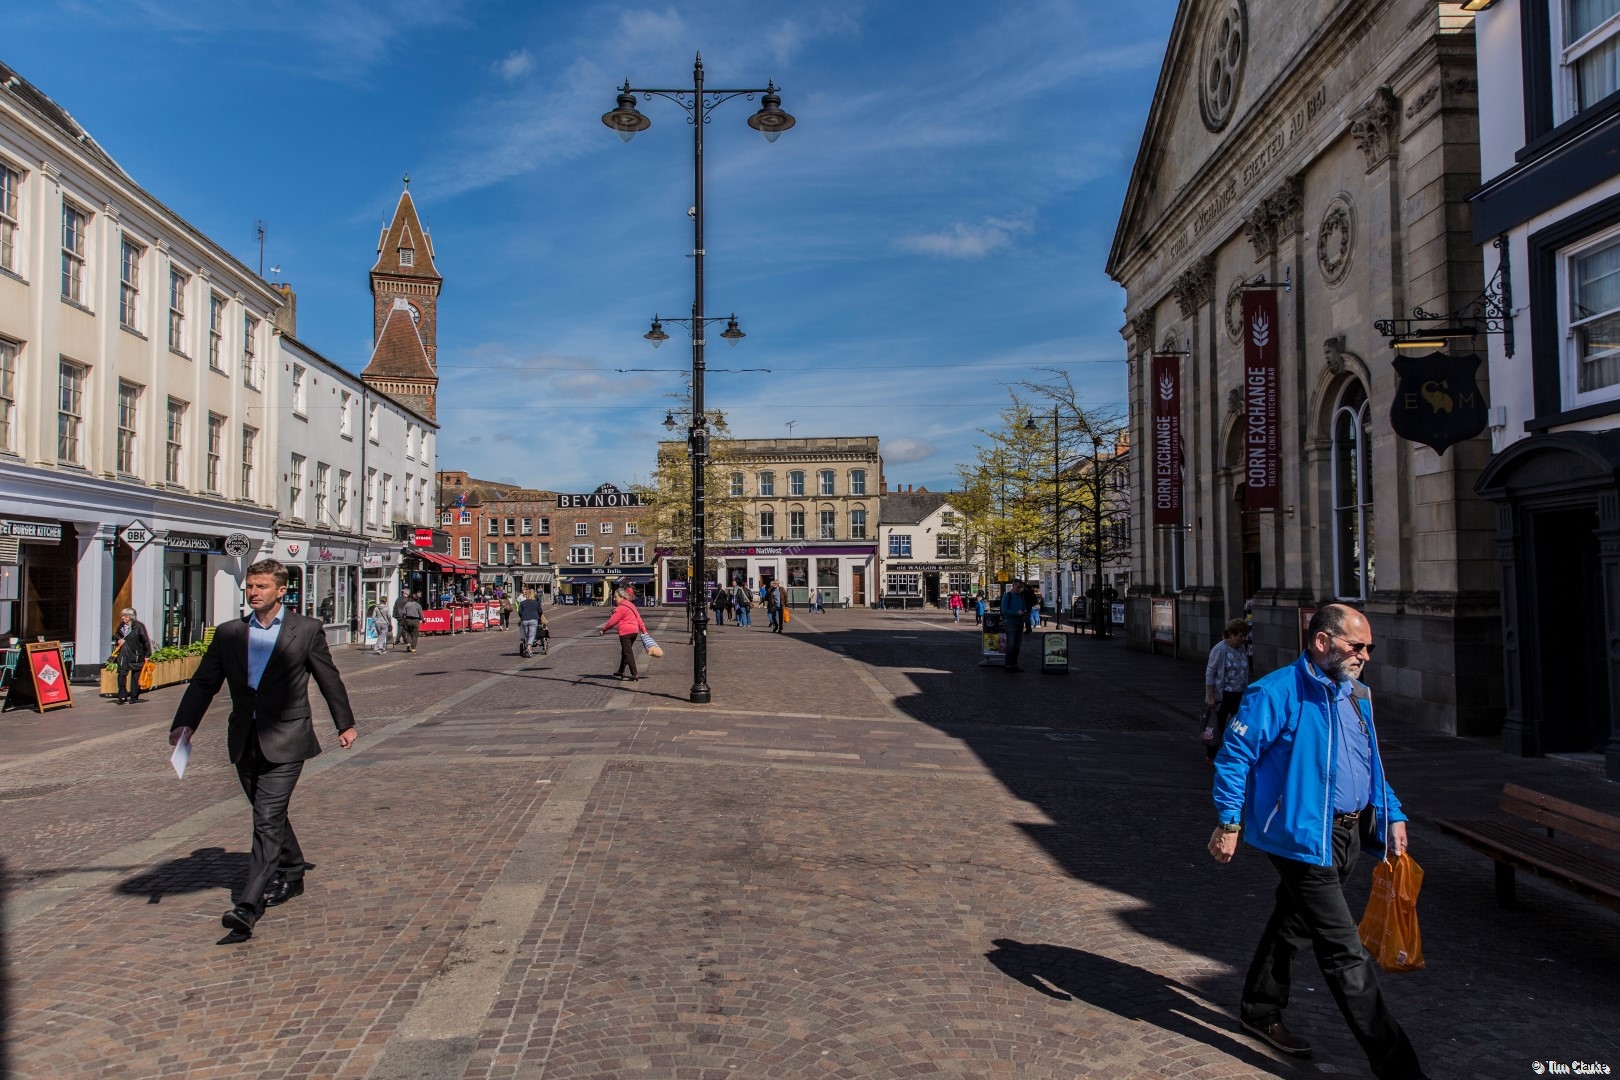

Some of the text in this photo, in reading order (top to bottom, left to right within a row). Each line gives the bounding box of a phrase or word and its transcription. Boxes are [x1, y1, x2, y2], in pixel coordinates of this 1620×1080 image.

[1242, 132, 1284, 187] ERECTED
[1267, 367, 1275, 380] BAR
[1403, 392, 1475, 409] E M
[1248, 367, 1266, 487] CORN EXCHANGE
[1268, 425, 1276, 450] CINEMA
[1157, 415, 1171, 509] CORN EXCHANGE
[1268, 459, 1276, 487] THEATRE
[12, 524, 36, 536] BURGER
[36, 526, 62, 538] KITCHEN
[127, 531, 146, 540] GBK
